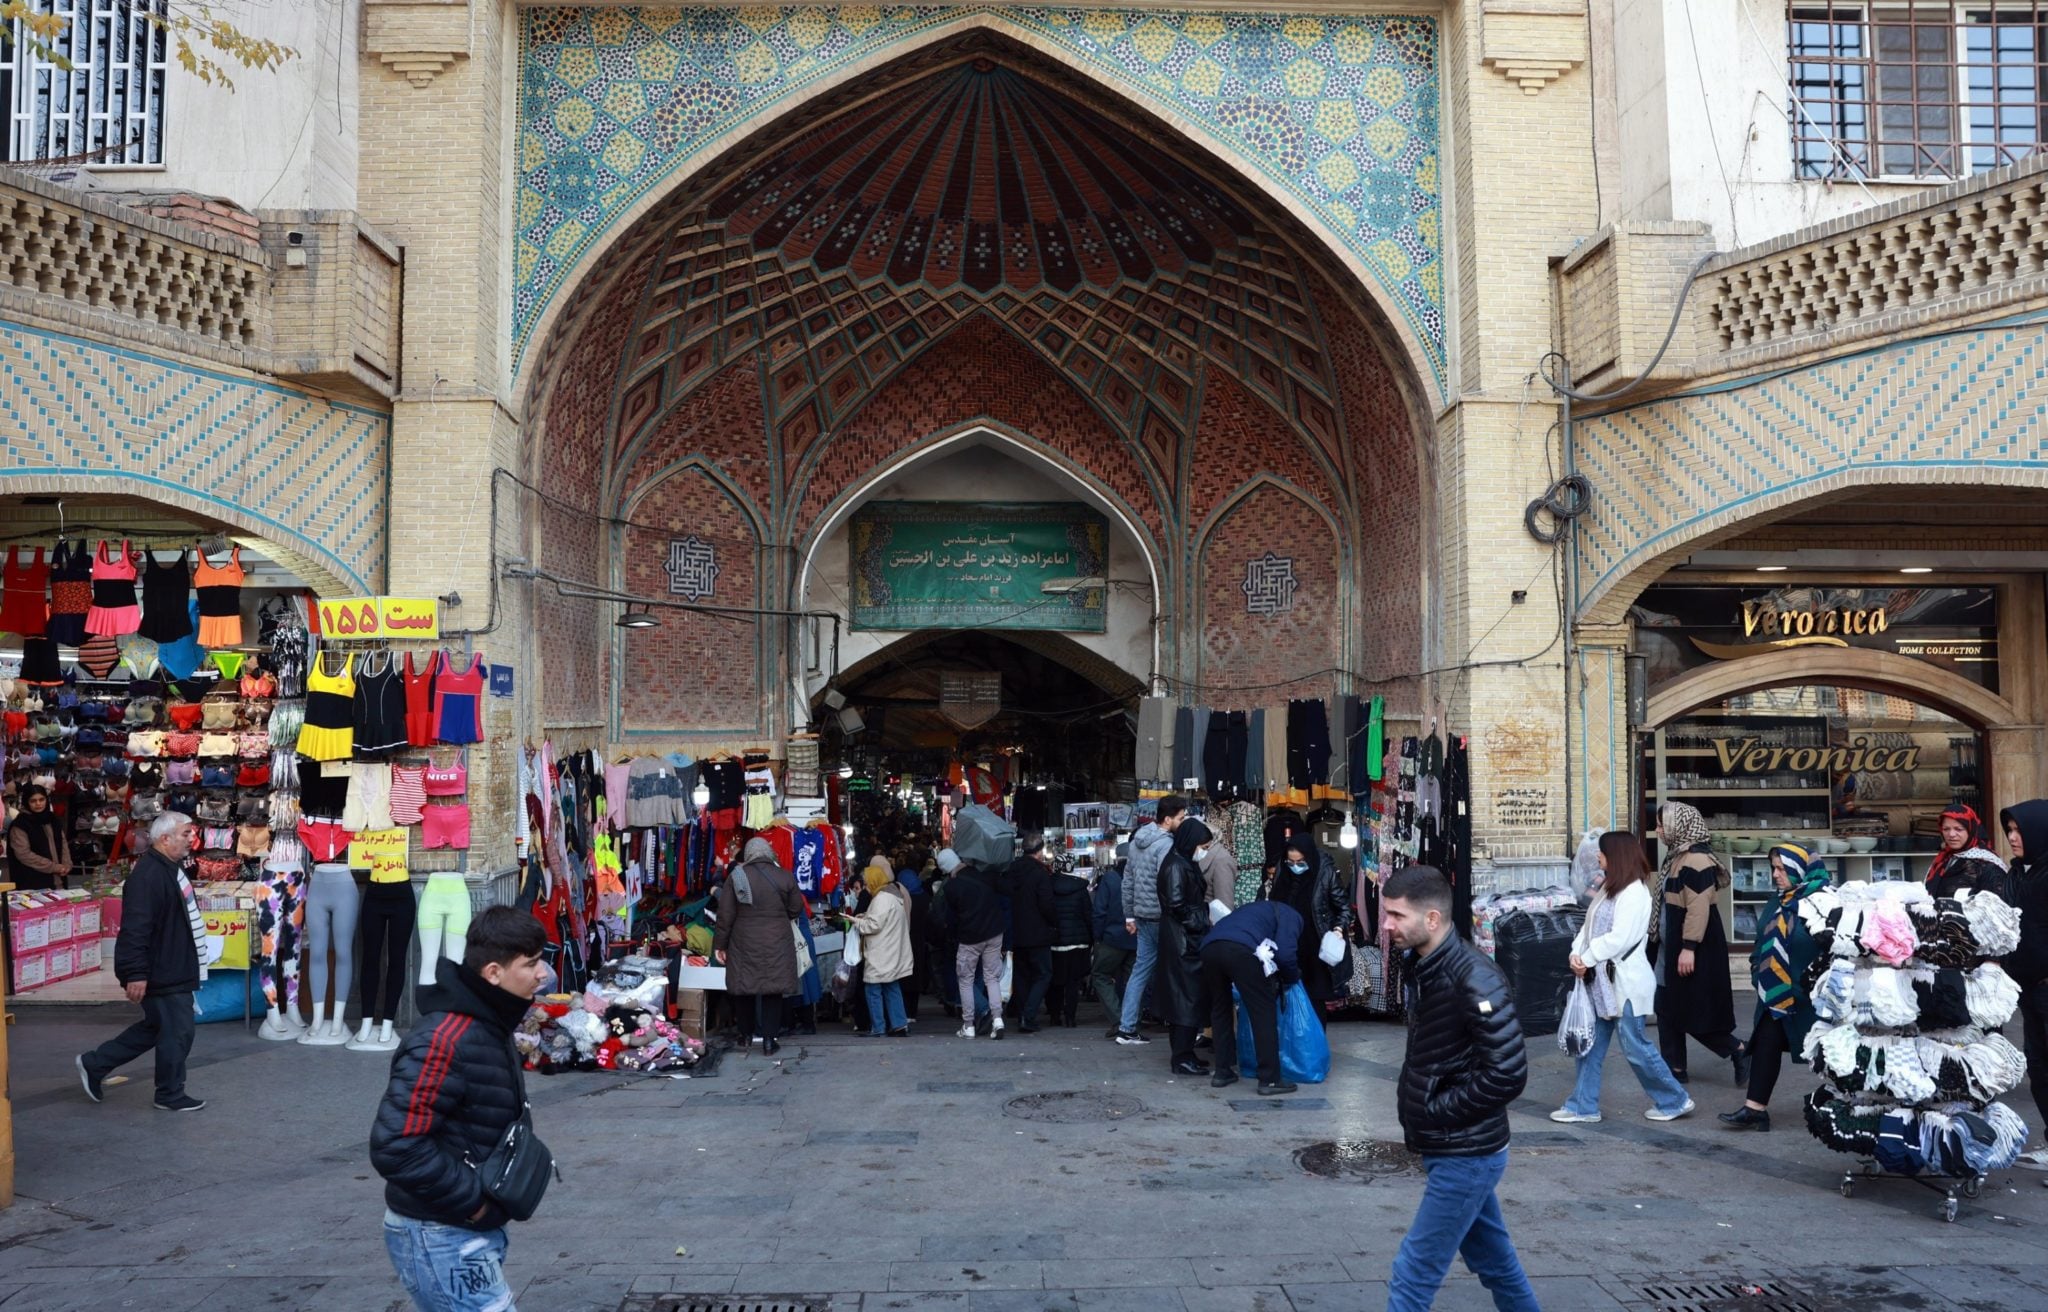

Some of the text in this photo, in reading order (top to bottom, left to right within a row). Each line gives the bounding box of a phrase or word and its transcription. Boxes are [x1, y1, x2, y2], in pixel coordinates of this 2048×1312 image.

[943, 532, 1015, 546] آستان مقدس
[889, 550, 1069, 568] امامزاده زید بن علی بن الحسین
[322, 603, 433, 634] ست ۱۵۵
[1743, 602, 1889, 637] Veronica
[1898, 646, 1981, 655] HOME COLLECTION
[1712, 737, 1921, 775] Veronica
[370, 834, 386, 844] گرم
[206, 915, 247, 936] شورت
